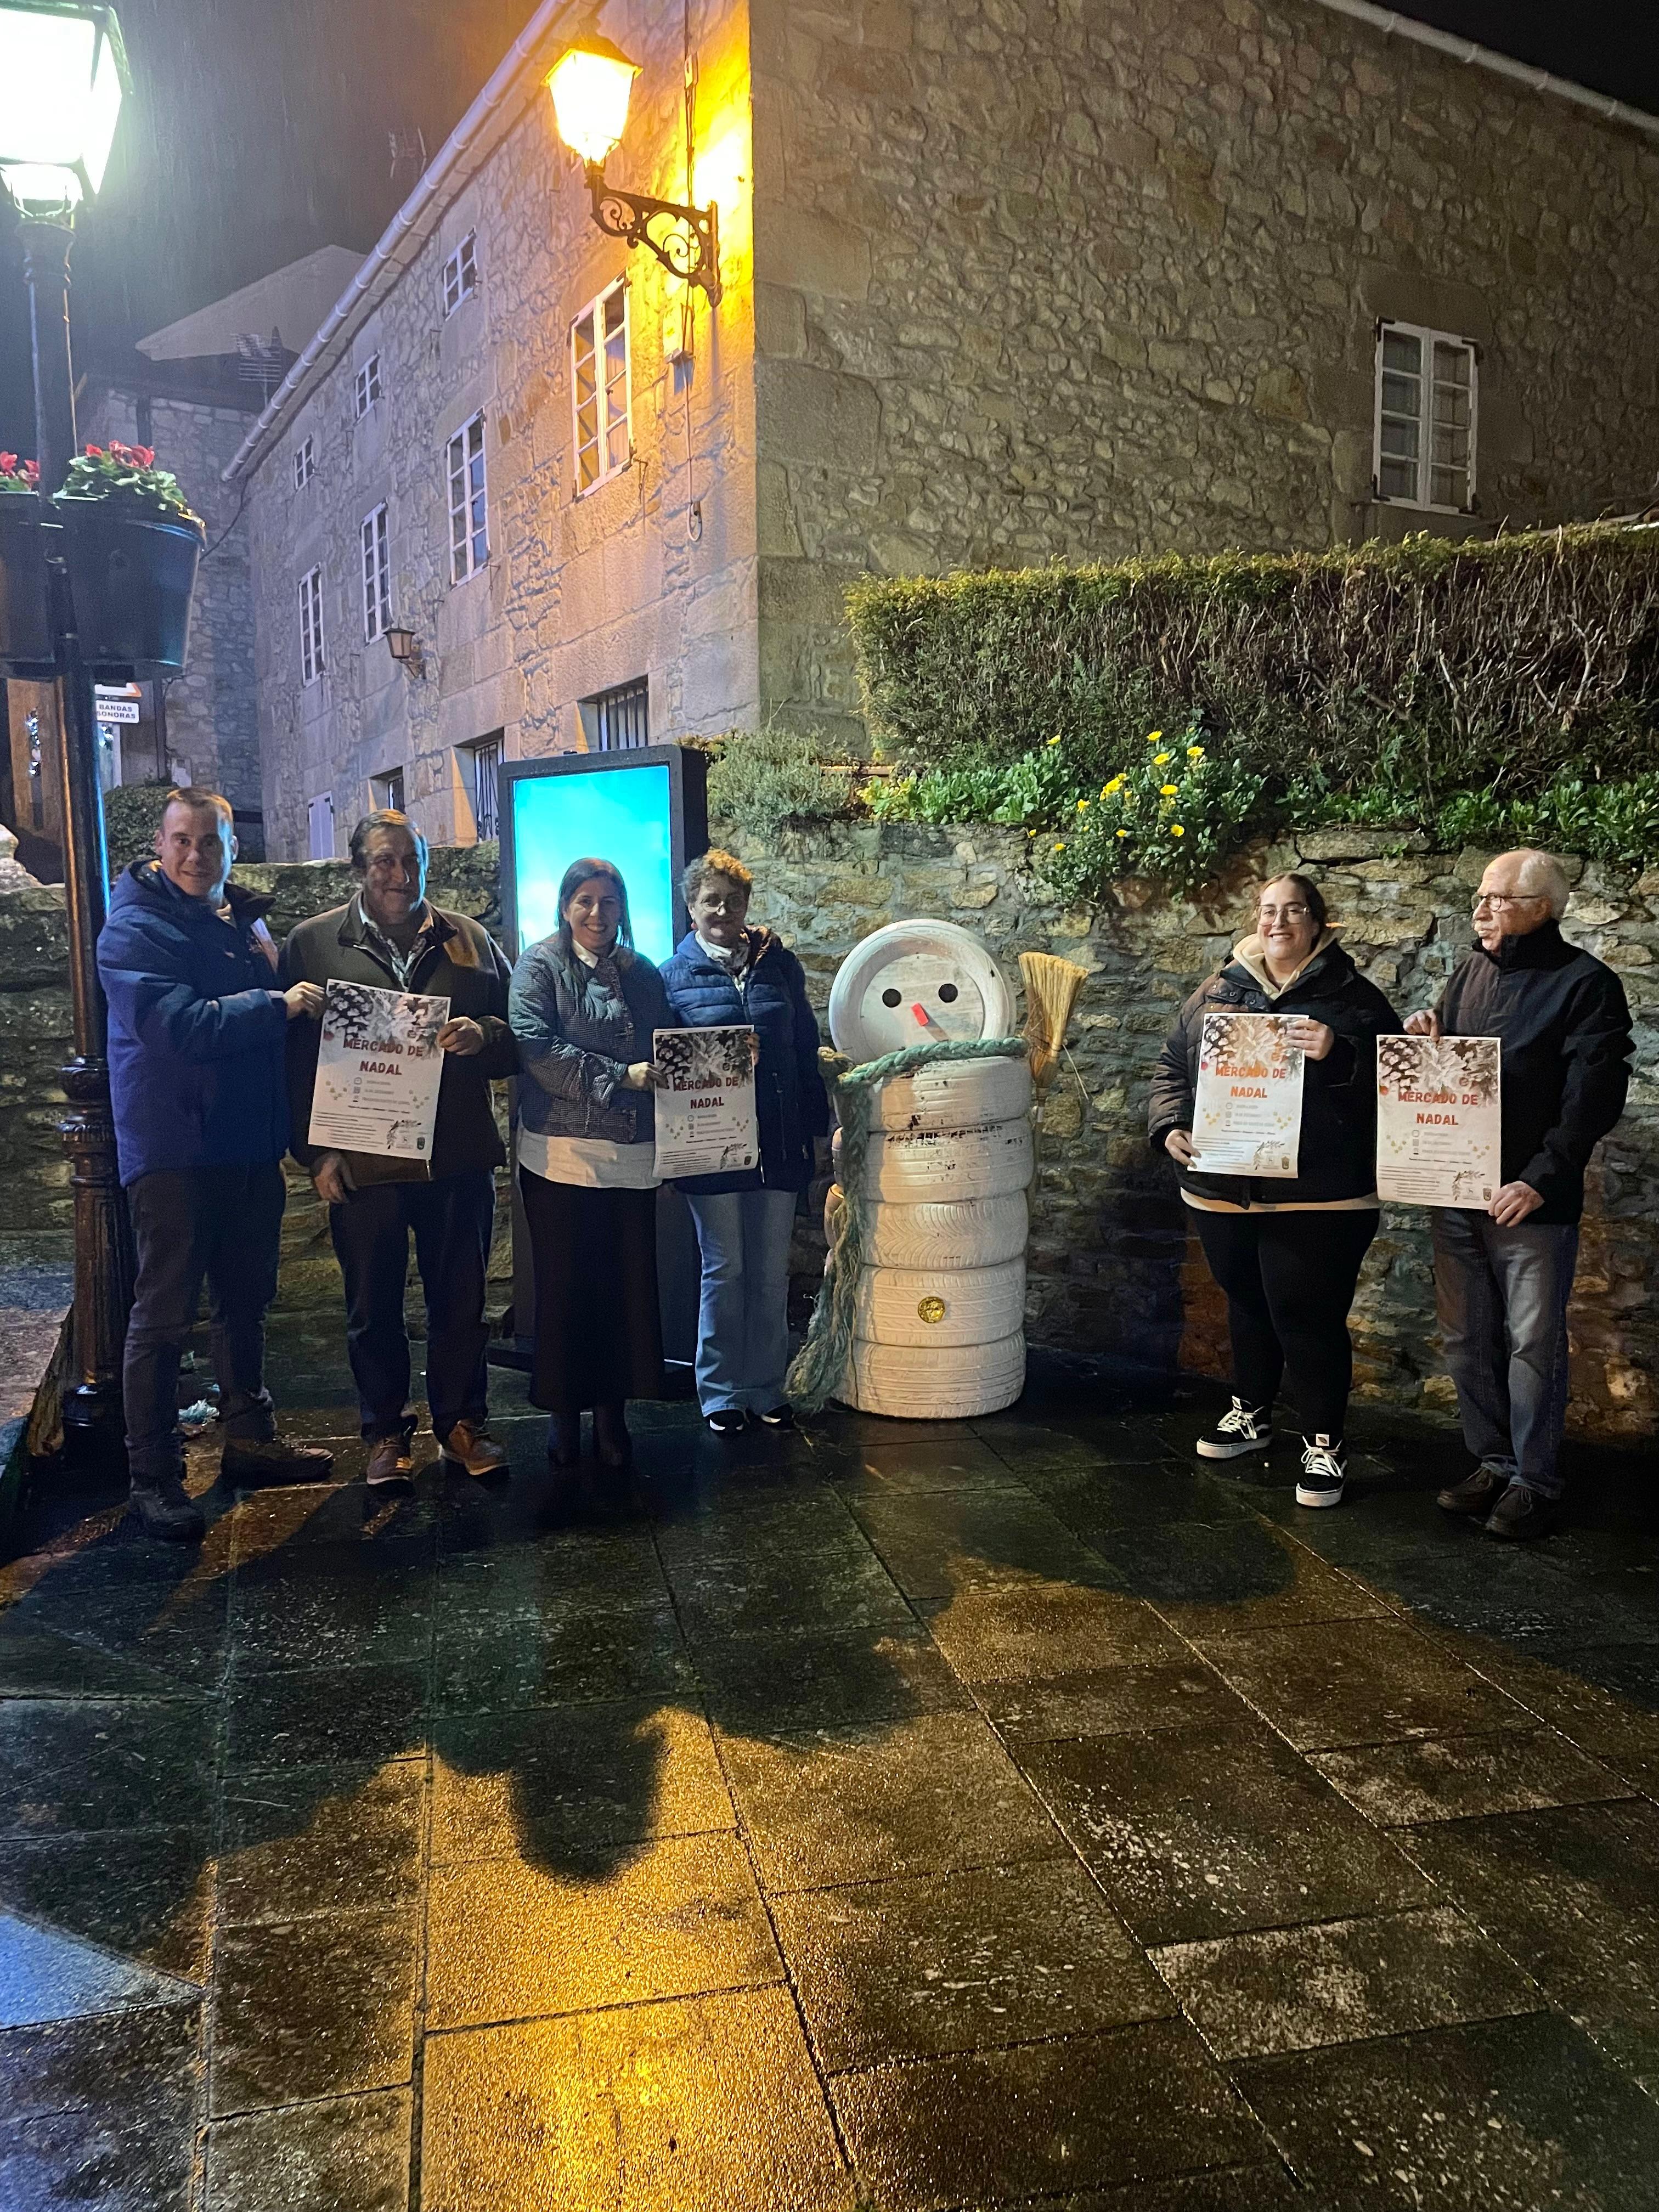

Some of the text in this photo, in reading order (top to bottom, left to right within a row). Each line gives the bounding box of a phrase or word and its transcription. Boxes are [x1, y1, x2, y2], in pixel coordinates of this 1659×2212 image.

[343, 1039, 423, 1057] MERCADO DE
[359, 1060, 402, 1075] NADAL
[1215, 1066, 1286, 1079] MERCADO DE
[673, 1076, 738, 1091] MERCADO DE
[1230, 1086, 1267, 1098] NADAL
[1398, 1091, 1479, 1105] MERCADO DE
[690, 1097, 724, 1109] NADAL
[1416, 1113, 1458, 1125] NADAL
